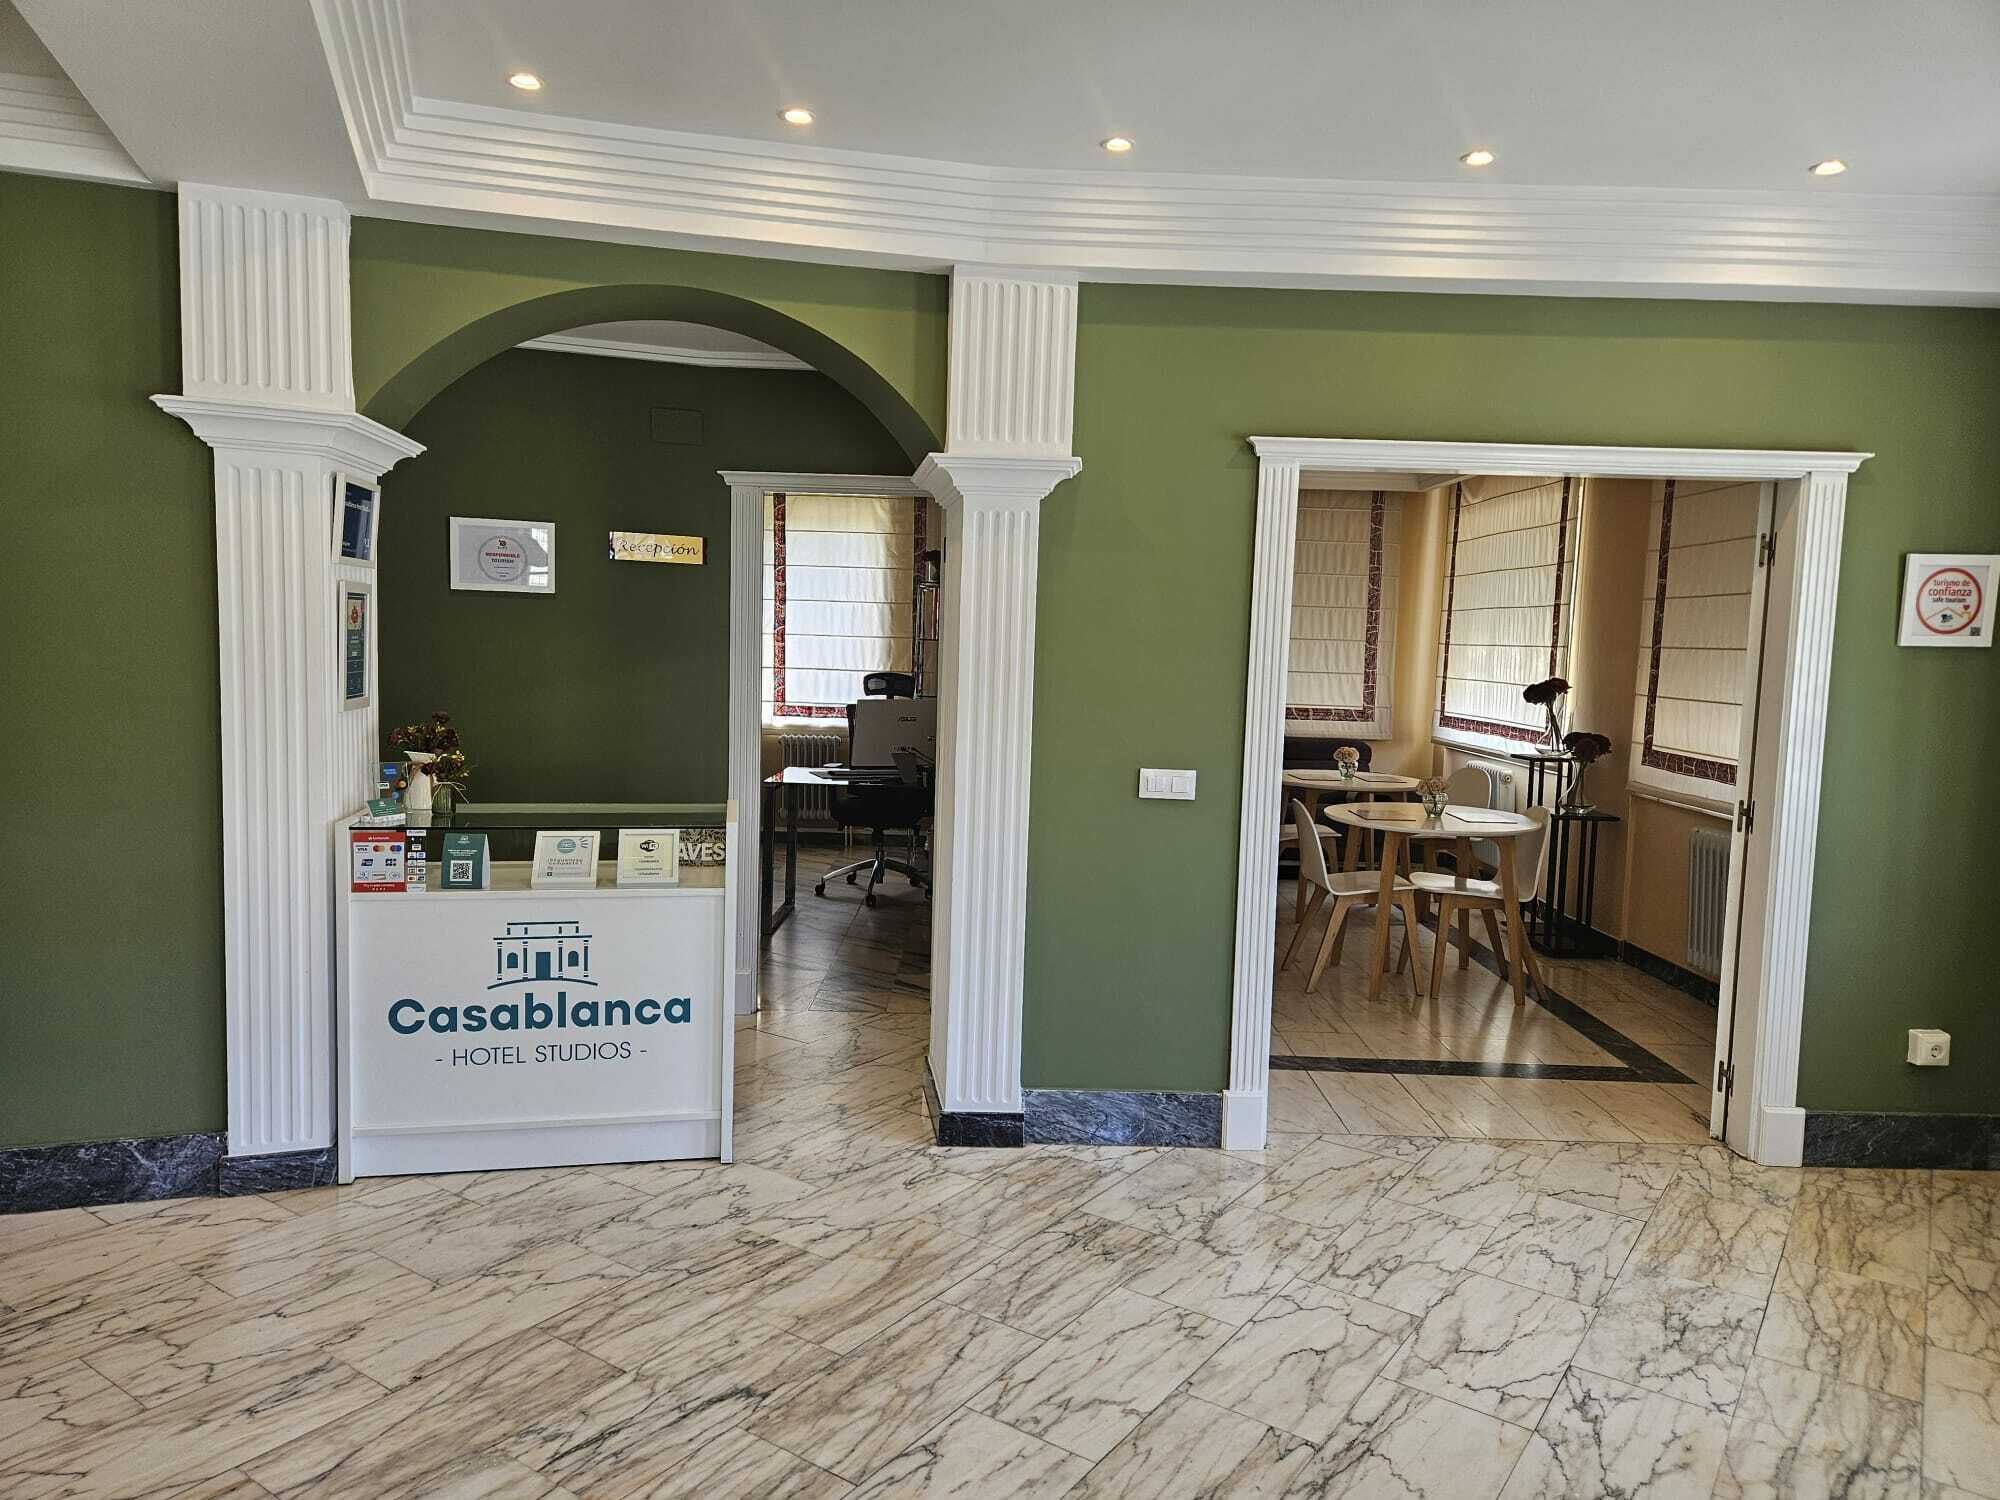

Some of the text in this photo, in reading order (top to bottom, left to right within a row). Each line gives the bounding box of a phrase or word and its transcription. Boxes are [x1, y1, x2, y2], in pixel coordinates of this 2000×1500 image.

[617, 539, 700, 557] Recepción
[1928, 588, 1972, 597] confianza
[388, 991, 691, 1035] Casablanca
[452, 1046, 526, 1067] HOTEL
[535, 1041, 632, 1063] STUDIOS
